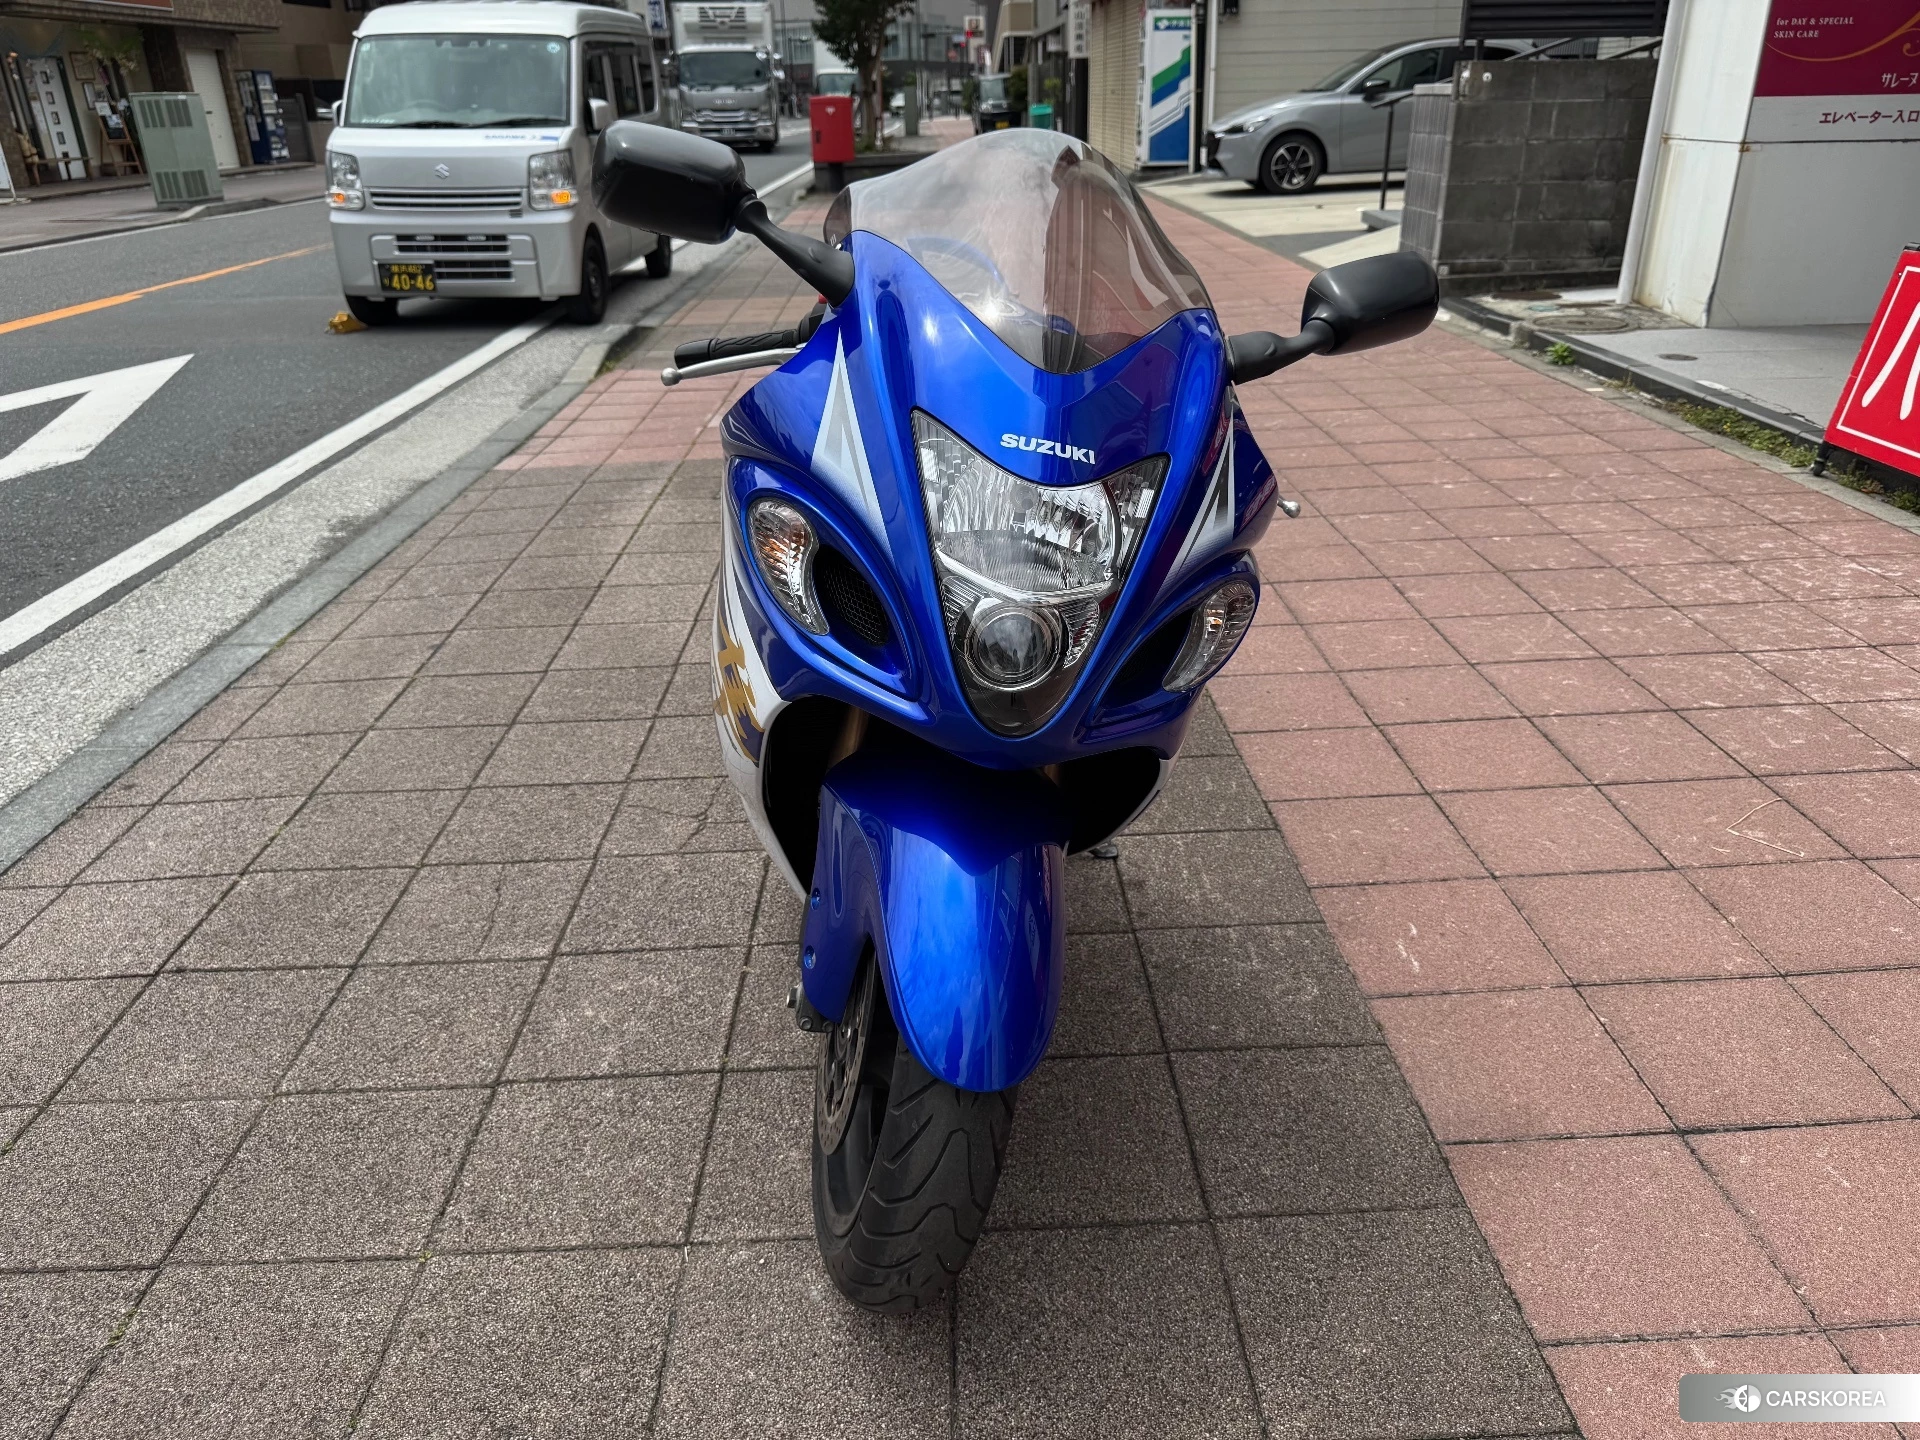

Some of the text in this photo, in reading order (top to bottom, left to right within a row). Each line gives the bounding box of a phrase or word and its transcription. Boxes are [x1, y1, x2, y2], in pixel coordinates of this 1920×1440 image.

[1776, 16, 1855, 26] for DAY & SPECIAL
[1773, 30, 1820, 39] SKIN CARE
[1881, 72, 1919, 88] サレーヌ
[1819, 110, 1920, 124] エレベーター入口
[392, 274, 434, 290] 40-46
[999, 433, 1096, 465] SUZUKI
